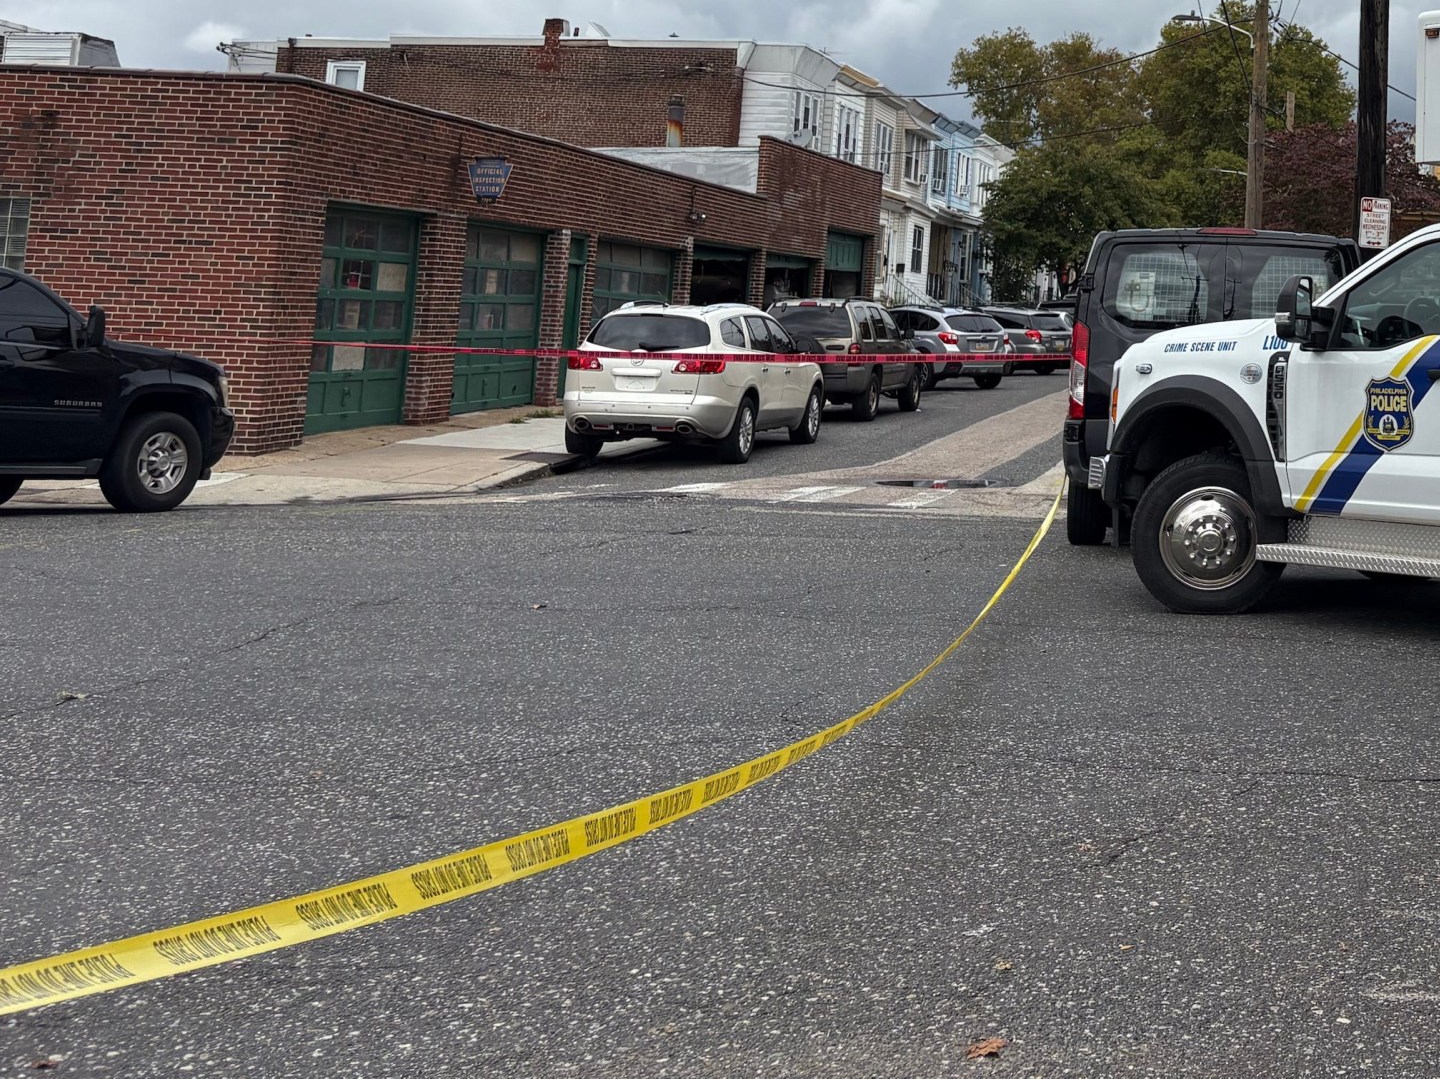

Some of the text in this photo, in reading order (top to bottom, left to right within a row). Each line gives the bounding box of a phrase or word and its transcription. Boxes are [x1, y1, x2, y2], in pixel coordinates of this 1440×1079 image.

[1363, 200, 1372, 210] NO
[1164, 341, 1238, 353] CRIME SCENE UNIT
[1369, 387, 1407, 395] PHILADELPHIA
[54, 399, 103, 407] SUBURBAN
[1370, 395, 1407, 412] POLICE
[153, 916, 281, 966] POLICE LINE DO NOT CROSS
